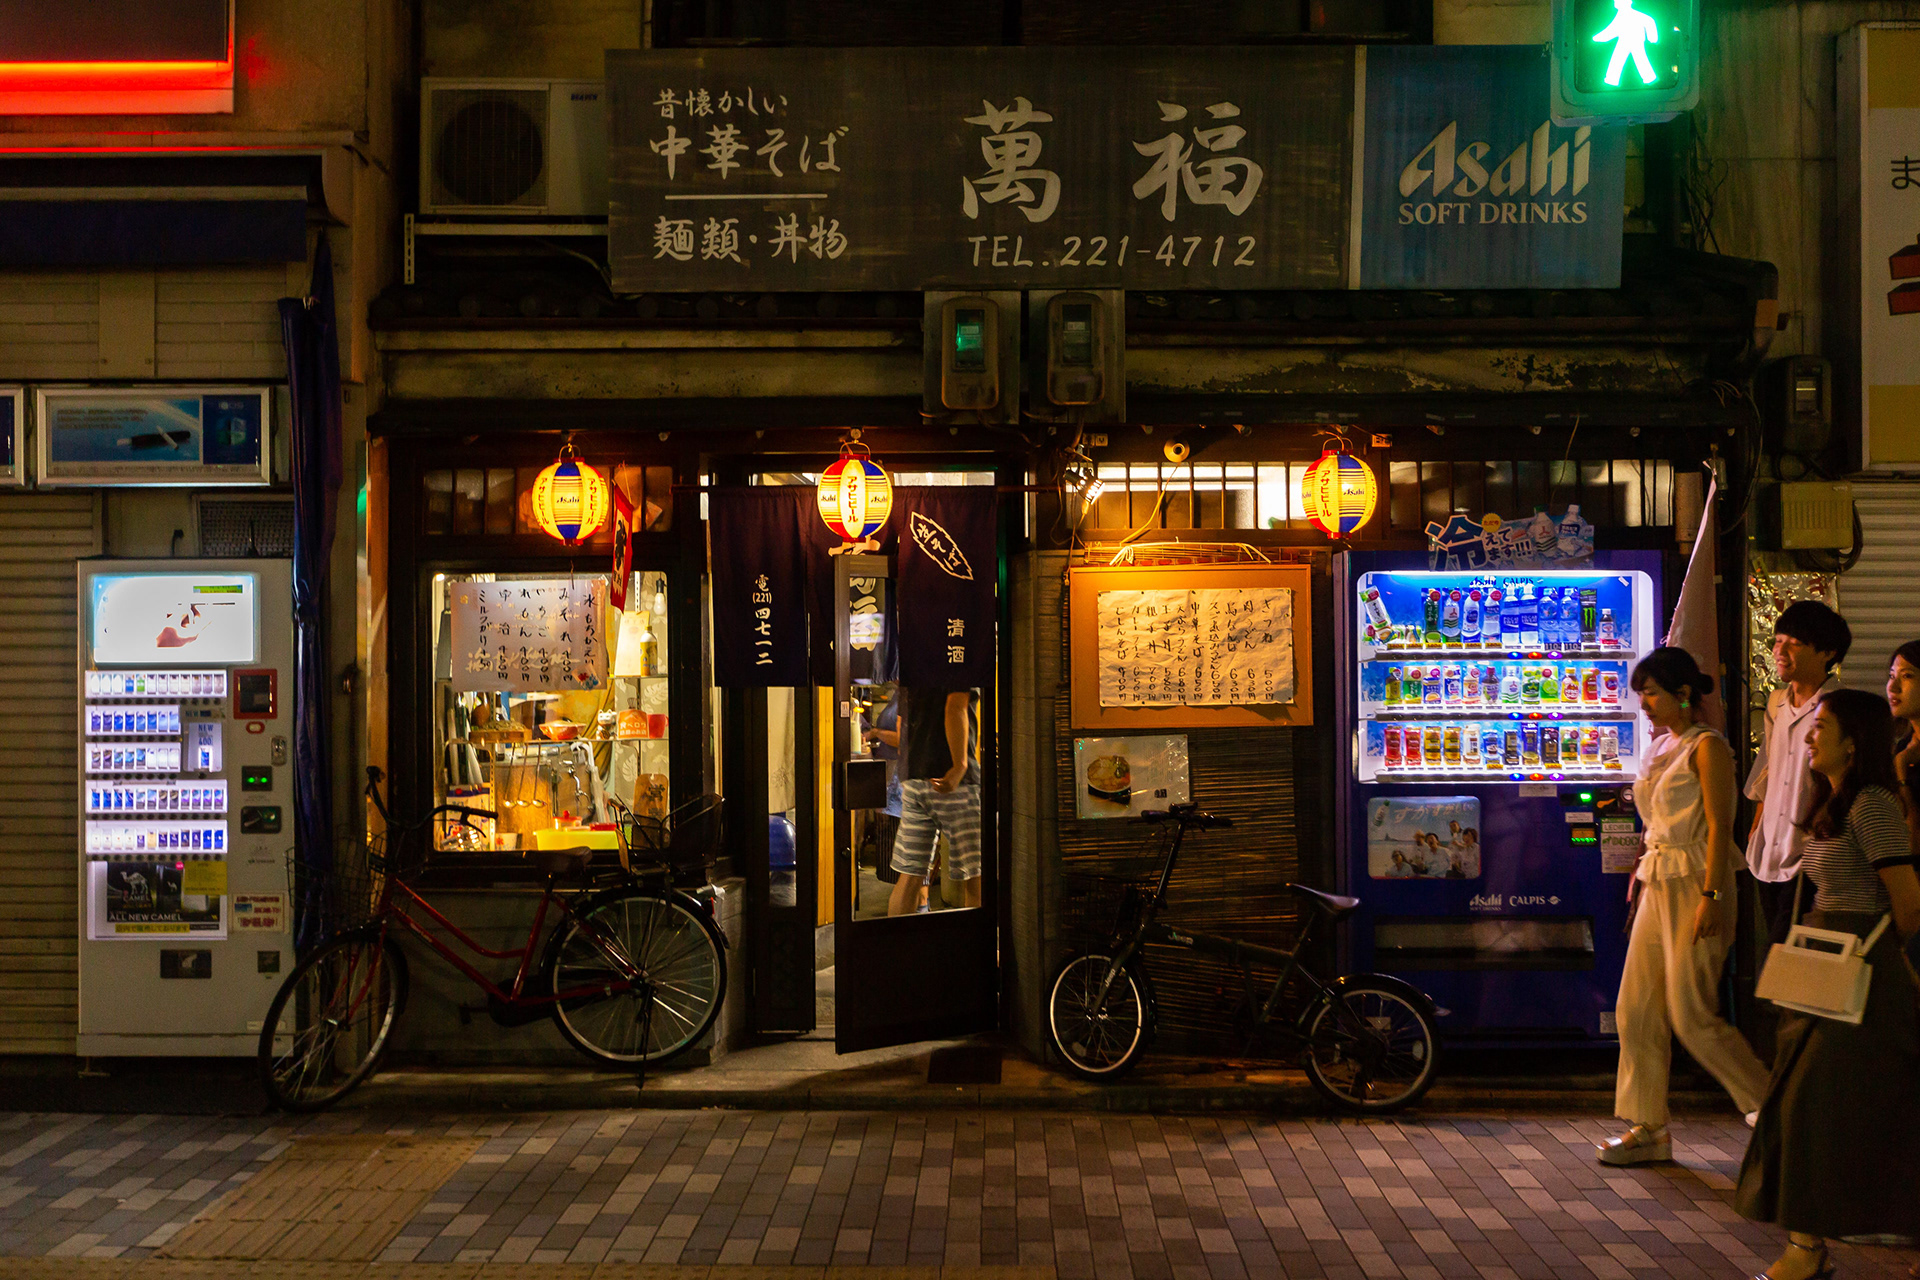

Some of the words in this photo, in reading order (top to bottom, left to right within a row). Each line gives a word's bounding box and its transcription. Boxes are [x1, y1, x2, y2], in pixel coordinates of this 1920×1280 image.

[652, 87, 789, 118] 昔懐かしい
[649, 123, 850, 180] 中華そば
[962, 95, 1265, 222] 萬福
[1398, 119, 1592, 198] Asahi
[652, 212, 848, 264] 麺類・丼物
[1398, 202, 1471, 226] SOFT
[1479, 201, 1588, 225] DRINKS
[556, 495, 581, 504] Asahi
[585, 477, 598, 526] アサヒビール
[846, 475, 859, 524] アサヒビール
[1320, 469, 1332, 518] アサヒビール
[946, 617, 967, 665] 清酒
[108, 913, 127, 921] ALL
[128, 913, 150, 921] NEW
[150, 913, 183, 921] CAMEL
[1469, 893, 1502, 907] Asahi
[1509, 895, 1546, 907] CALPIS
